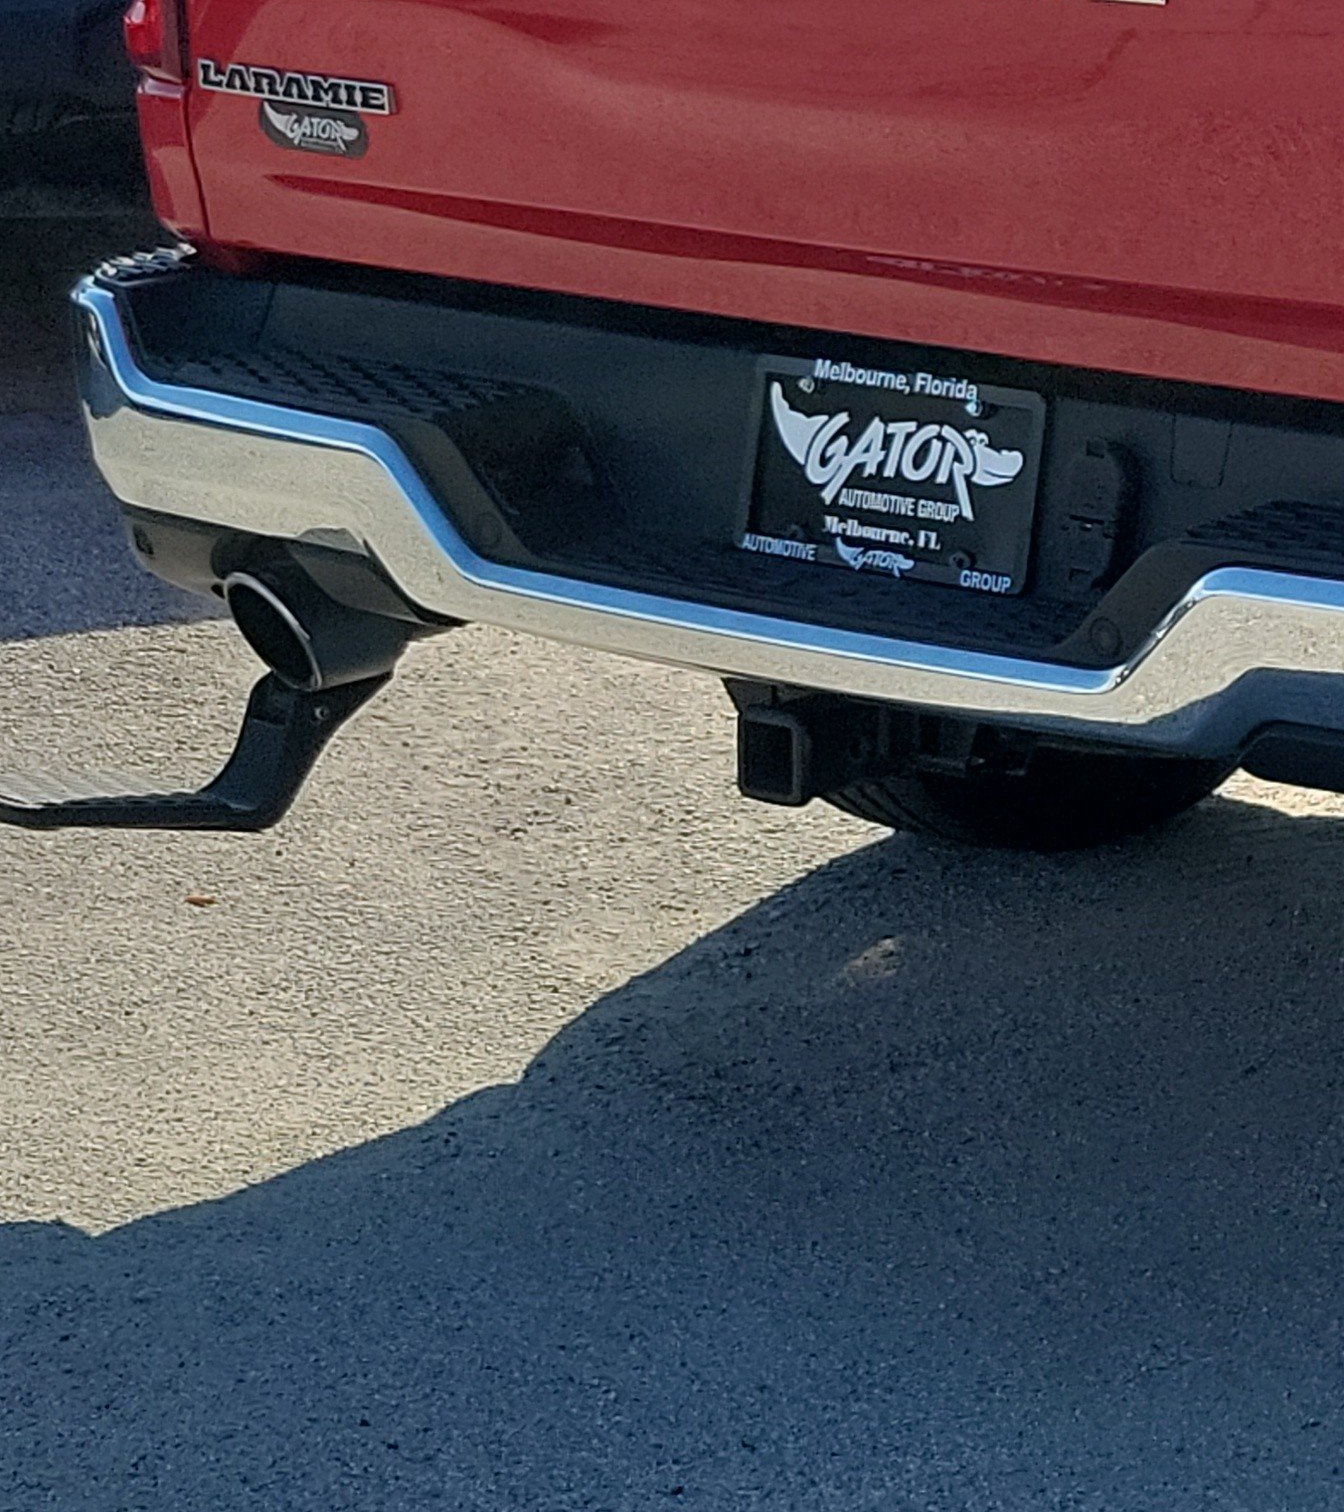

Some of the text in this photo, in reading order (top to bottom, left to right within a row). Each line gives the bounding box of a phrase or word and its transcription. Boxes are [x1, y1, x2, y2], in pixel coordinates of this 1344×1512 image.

[198, 58, 392, 115] LARAMIE
[284, 113, 347, 151] GATOR
[814, 358, 978, 401] Melbourne, Florida
[805, 411, 974, 522] GATOR
[839, 487, 960, 522] AUTOMOTIVE GROUP
[743, 534, 818, 561] AUTOMOTIVE
[960, 570, 1011, 593] GROUP
